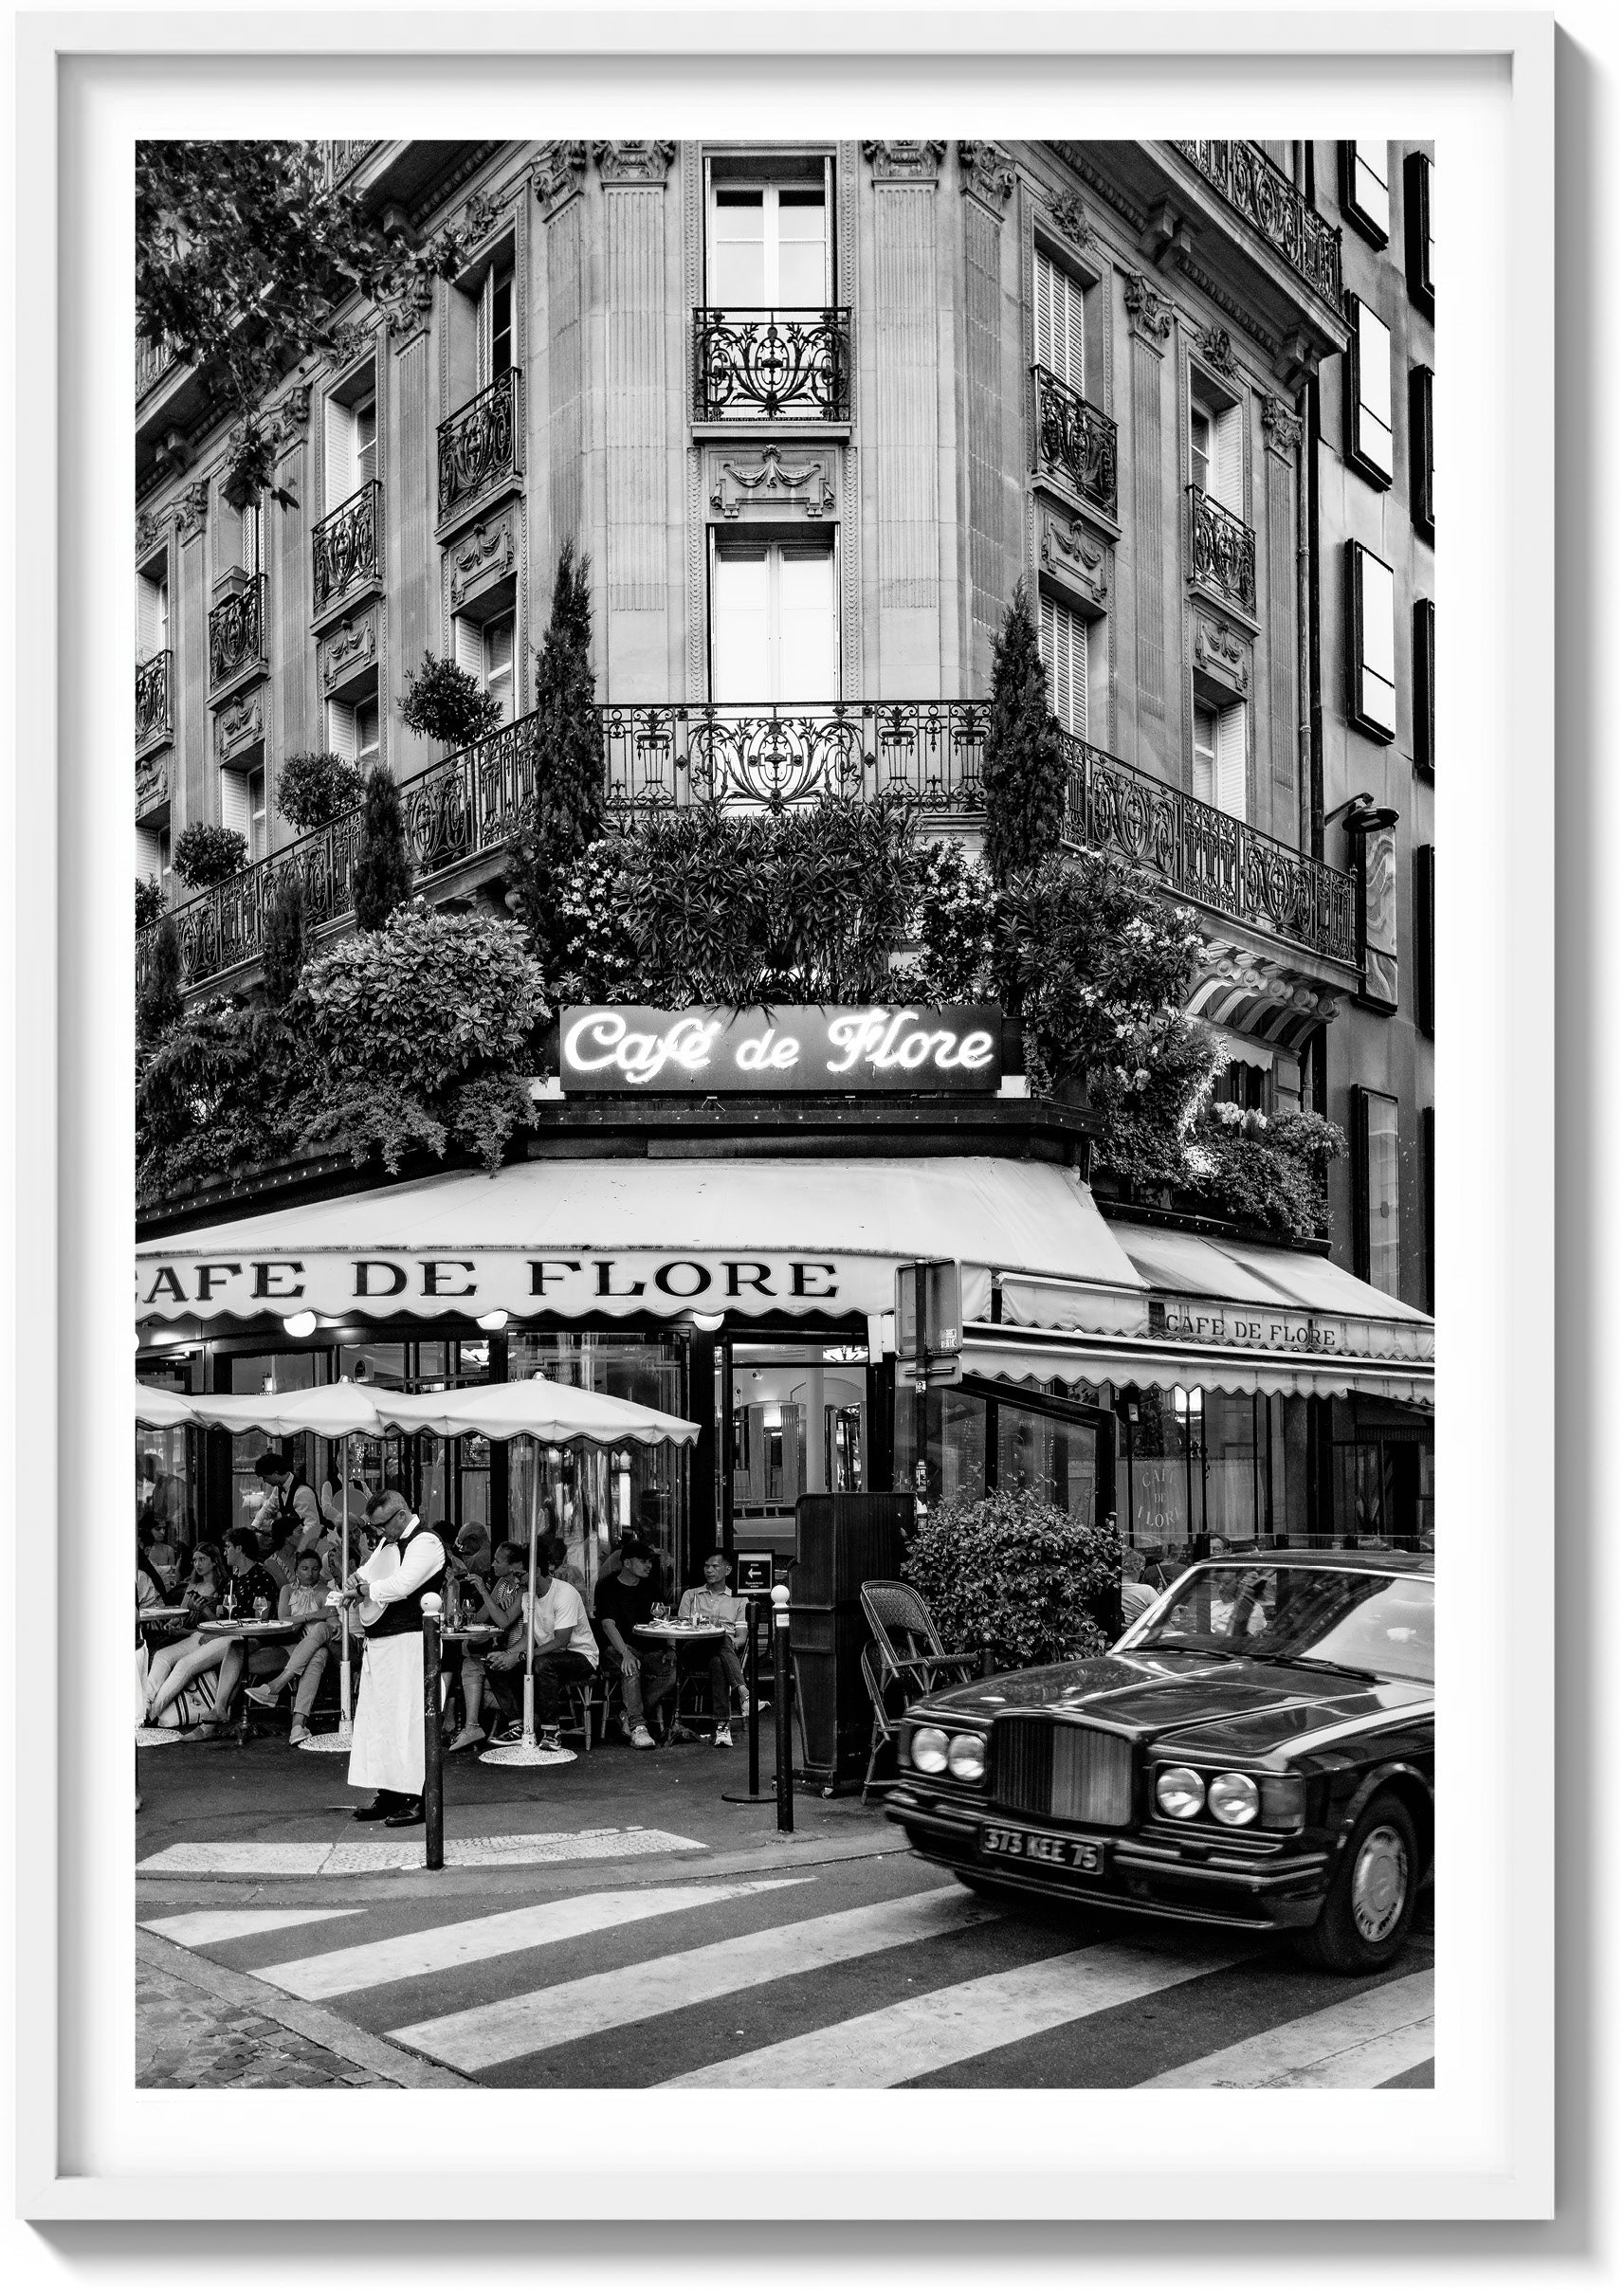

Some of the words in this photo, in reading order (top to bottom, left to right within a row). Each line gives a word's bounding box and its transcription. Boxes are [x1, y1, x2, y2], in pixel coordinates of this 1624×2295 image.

[566, 1011, 723, 1084] Café
[736, 1029, 801, 1069] de
[826, 1009, 994, 1072] Flore
[135, 1261, 306, 1304] AFE
[351, 1260, 478, 1298] DE
[525, 1260, 839, 1298] FLORE
[1165, 1314, 1225, 1336] CAFE
[1234, 1321, 1262, 1339] DE
[1269, 1324, 1336, 1346] FLORE
[985, 1828, 1023, 1853] 373
[1069, 1843, 1098, 1868] 75
